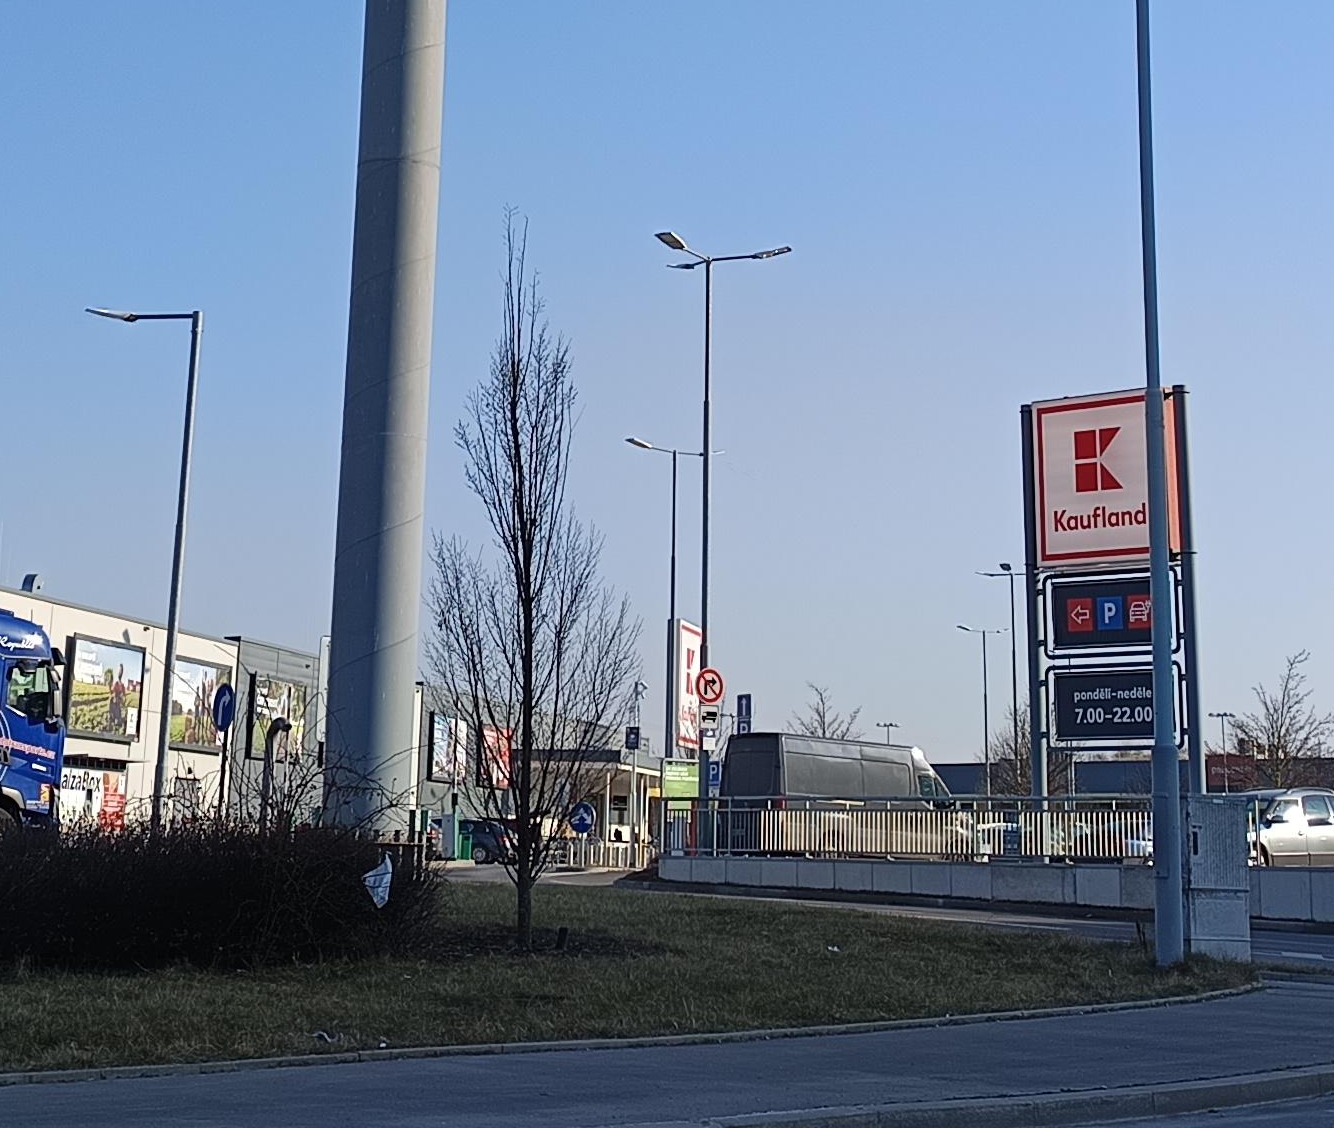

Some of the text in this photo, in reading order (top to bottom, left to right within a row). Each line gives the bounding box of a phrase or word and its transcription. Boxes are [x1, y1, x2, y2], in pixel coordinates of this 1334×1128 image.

[1053, 502, 1147, 533] Kaufland
[1103, 602, 1116, 624] P
[1074, 706, 1153, 724] 7.00-22.00
